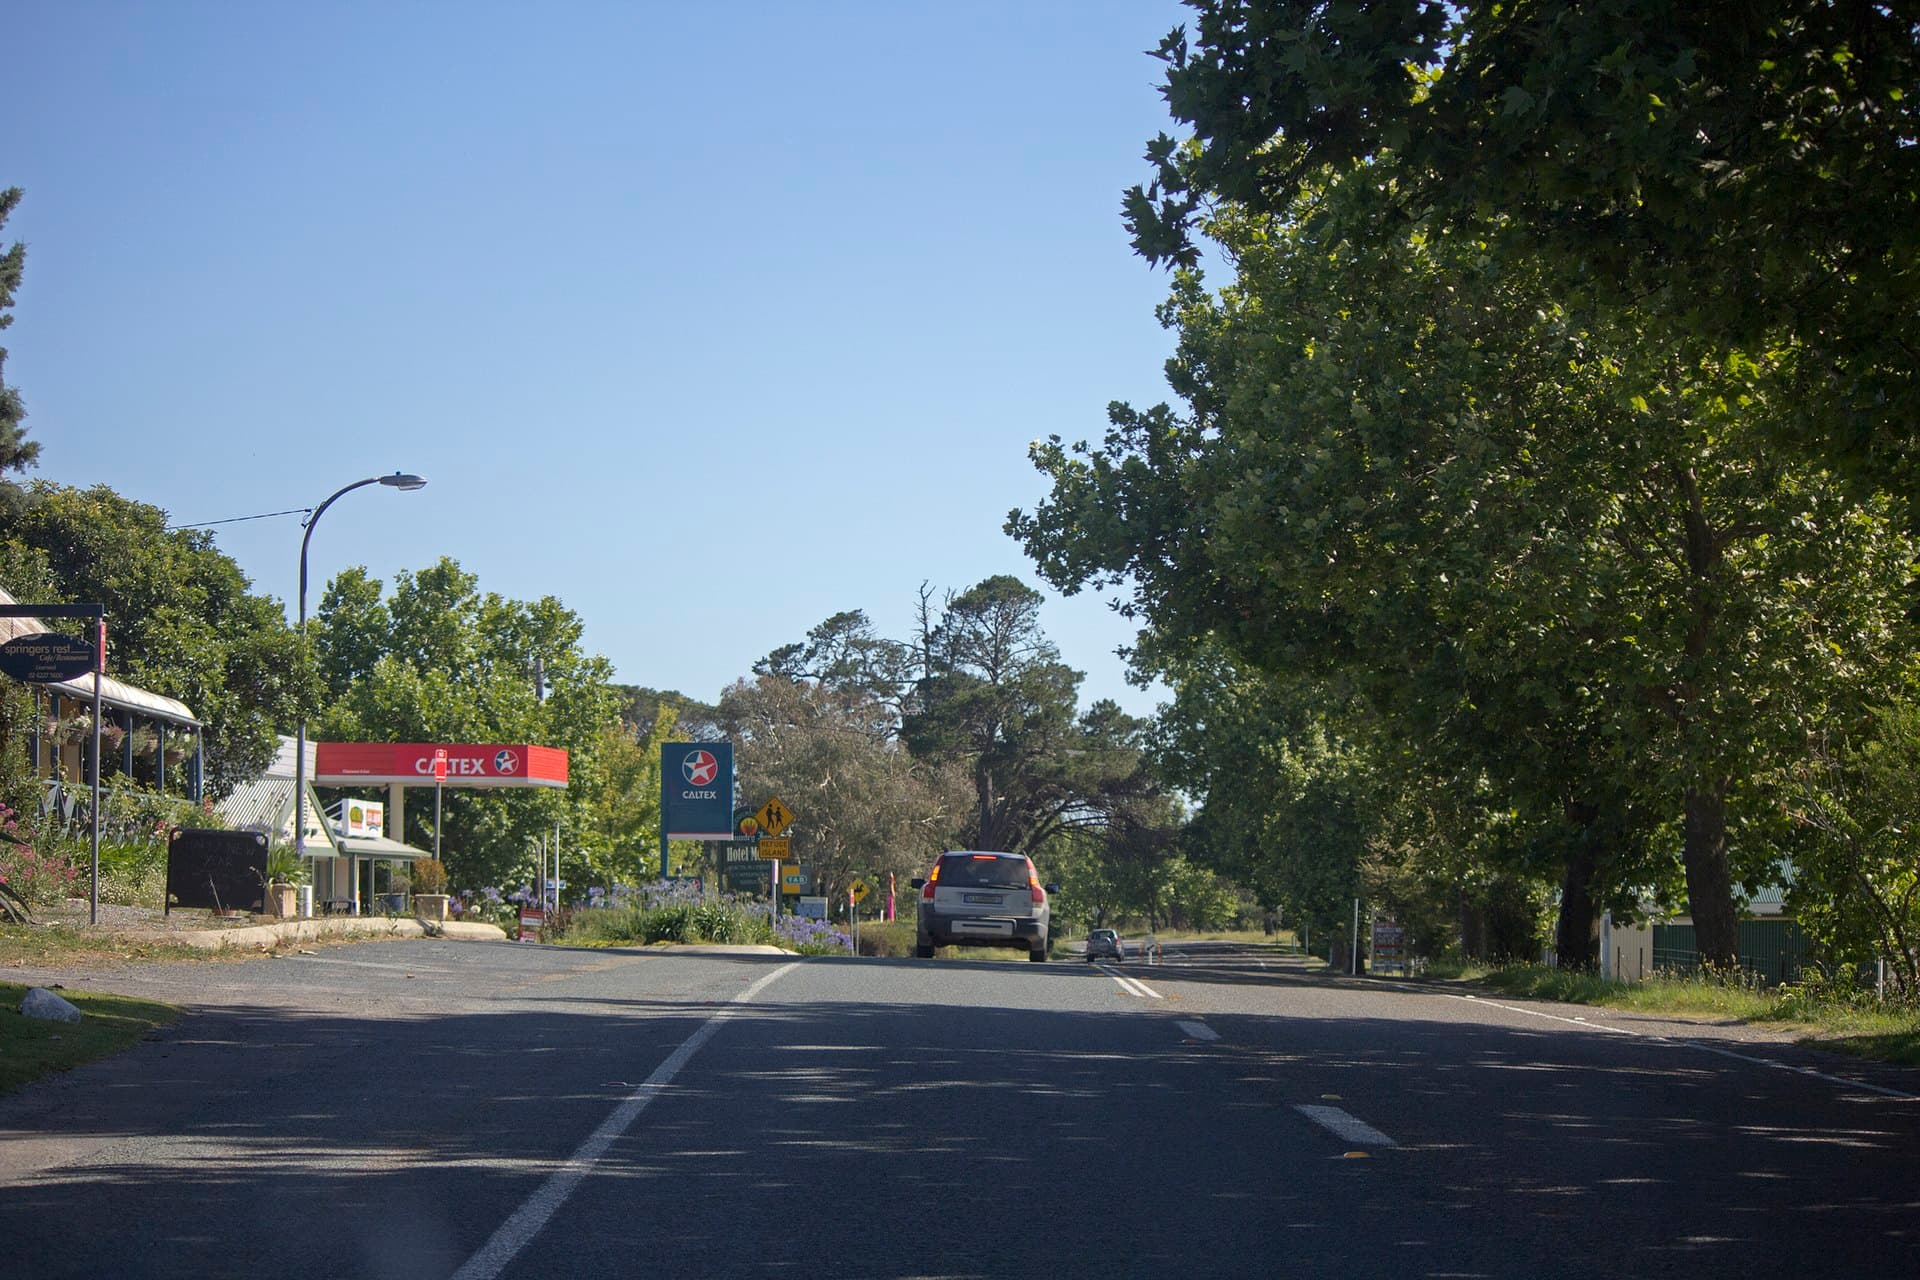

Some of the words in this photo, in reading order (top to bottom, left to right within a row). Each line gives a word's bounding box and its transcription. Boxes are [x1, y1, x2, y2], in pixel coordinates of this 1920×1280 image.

[4, 643, 50, 656] springers
[52, 643, 71, 654] rest
[682, 790, 717, 799] CALTEX
[726, 846, 749, 862] Hotel
